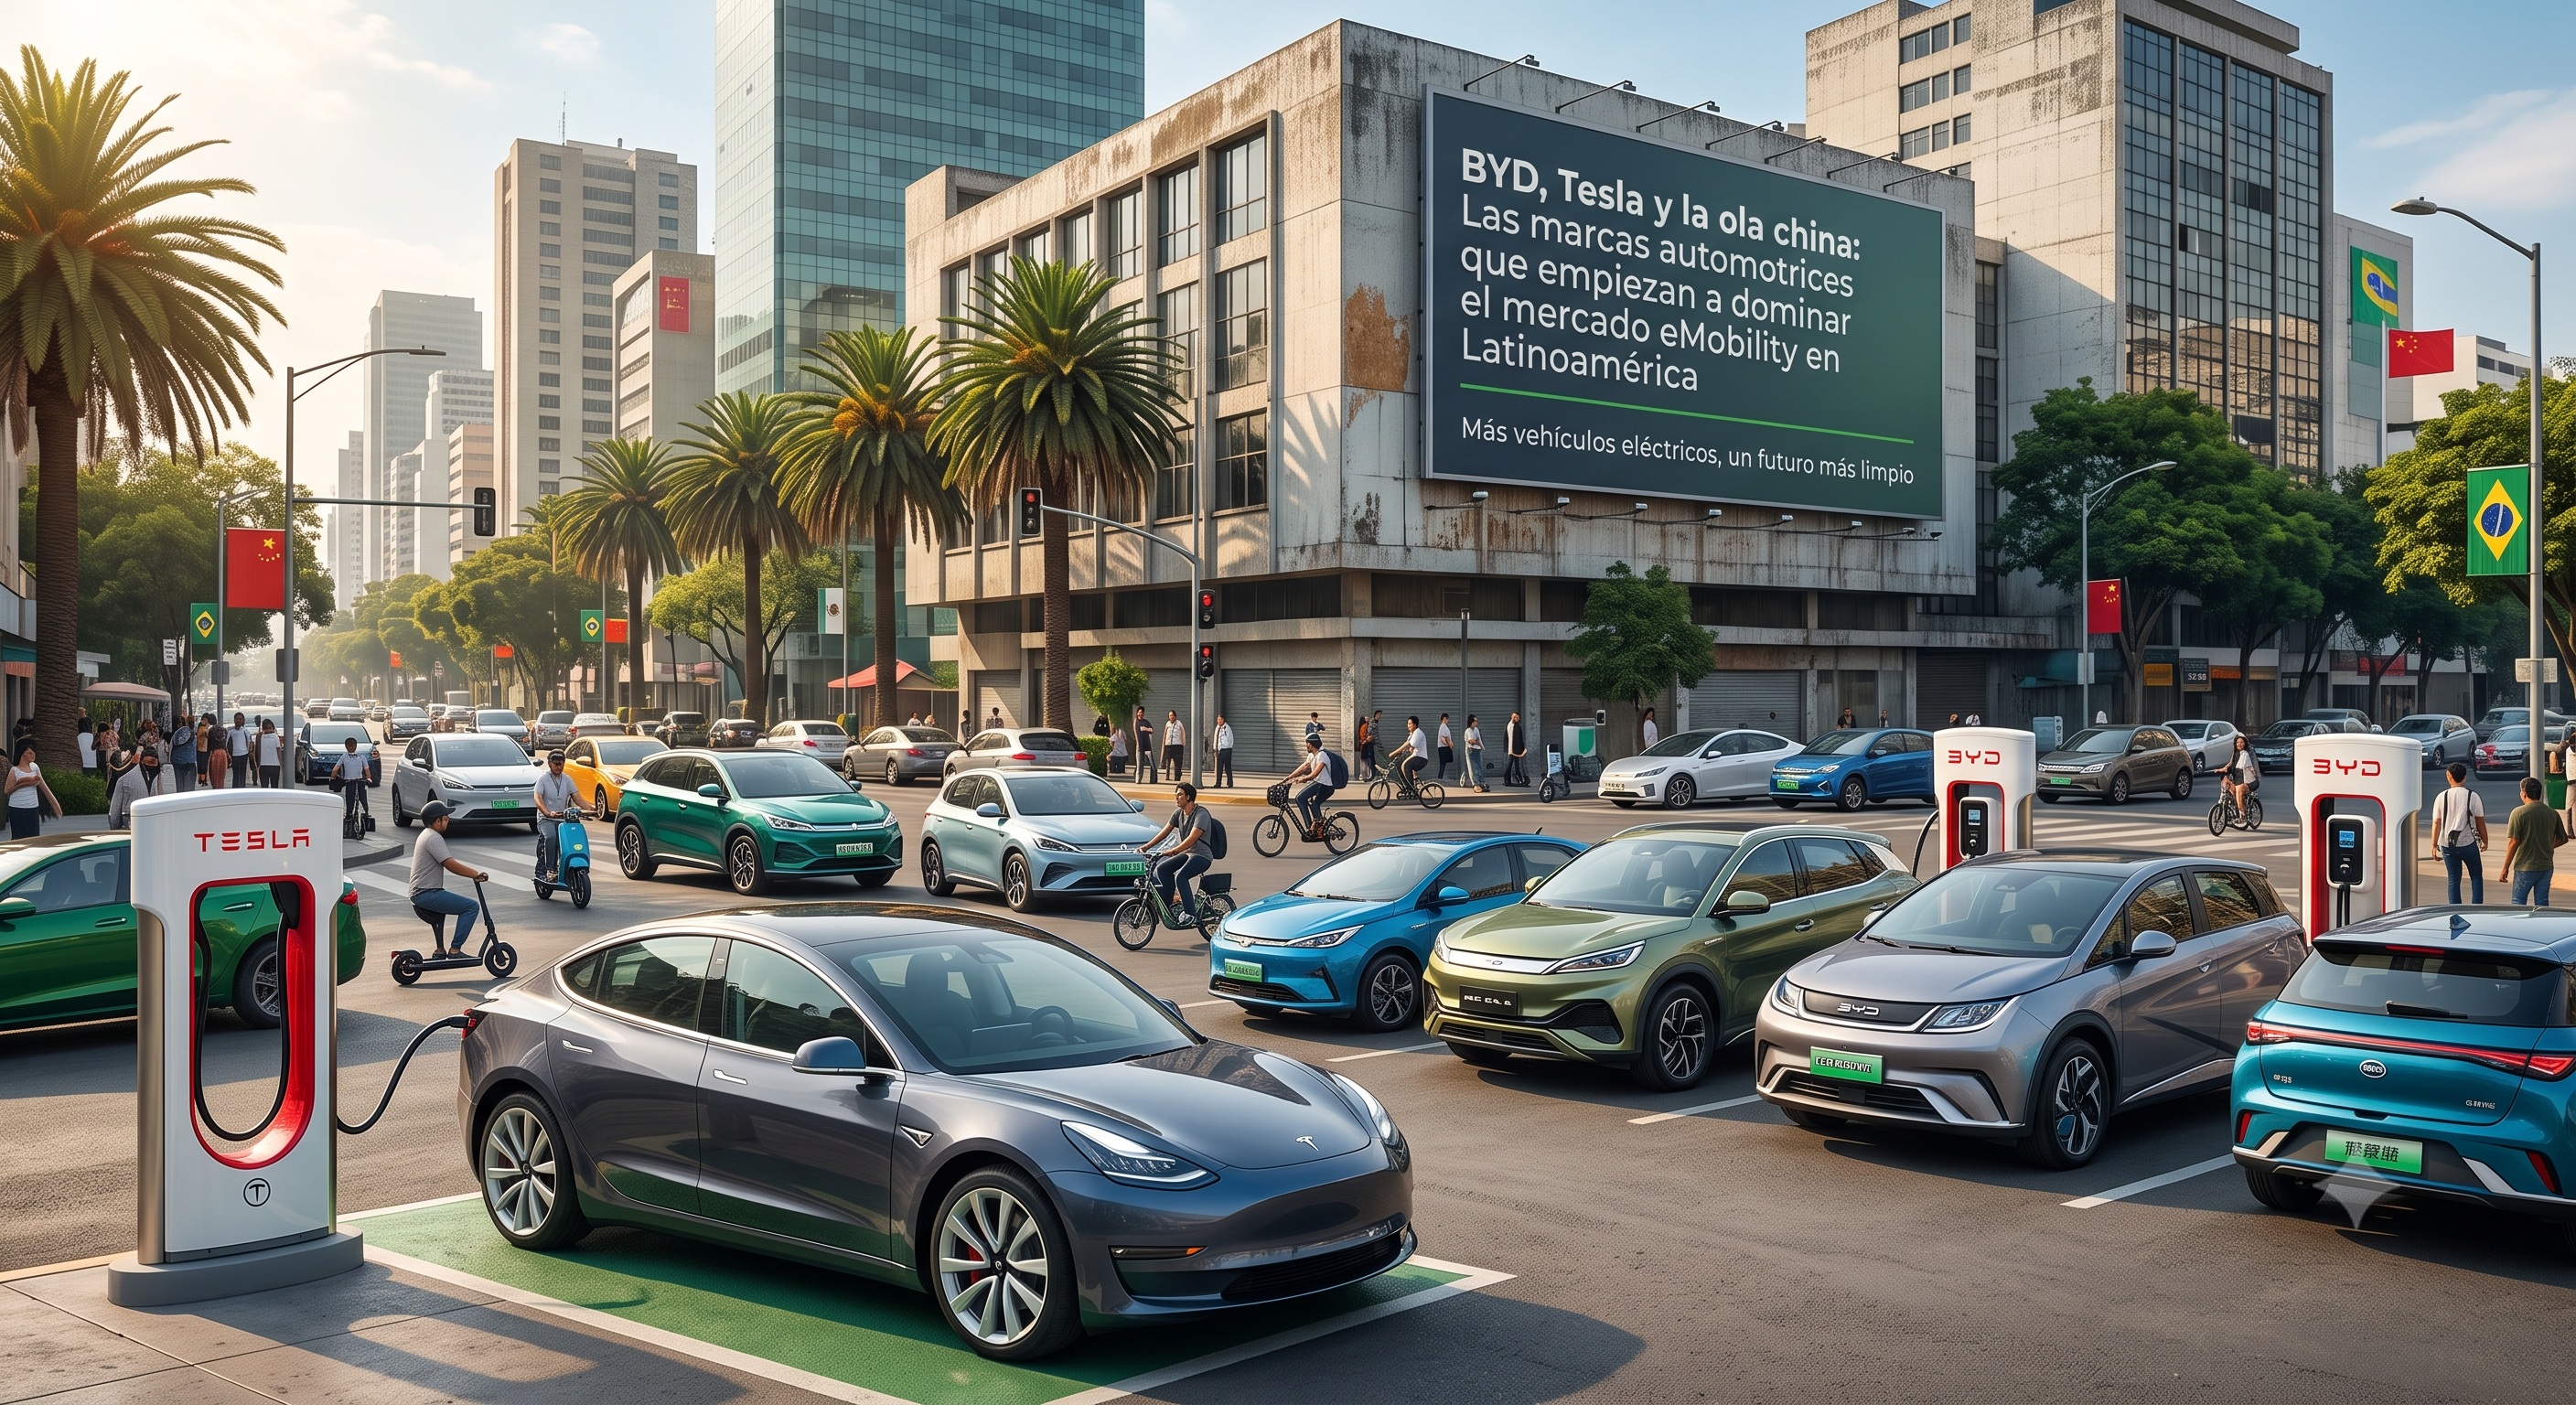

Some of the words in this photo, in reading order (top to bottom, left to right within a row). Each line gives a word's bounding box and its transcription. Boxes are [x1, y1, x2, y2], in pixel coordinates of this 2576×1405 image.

[1463, 147, 1548, 203] BYD,
[1558, 168, 1643, 216] Tesla
[1653, 196, 1673, 228] y
[1683, 193, 1708, 230] la
[1719, 205, 1764, 241] ola
[1774, 217, 1860, 261] china:
[1464, 193, 1519, 234] Las
[1531, 214, 1650, 259] marcas
[1660, 241, 1853, 297] automotrices
[1461, 246, 1528, 282] que
[1539, 260, 1695, 309] empiezan
[1706, 289, 1722, 314] a
[1732, 287, 1851, 335] dominar
[1461, 284, 1489, 318] el
[1504, 297, 1650, 342] mercado
[1660, 318, 1798, 372] eMobility
[1806, 347, 1839, 372] en
[1464, 327, 1697, 391] Latinoamérica
[1463, 416, 1508, 443] Más
[1513, 424, 1615, 454] vehículos
[1622, 434, 1722, 468] eléctricos,
[1729, 451, 1751, 467] un
[1757, 448, 1814, 474] futuro
[1819, 457, 1856, 478] más
[1862, 459, 1914, 487] limpio
[1948, 749, 2002, 766] BYD
[2313, 758, 2382, 778] BYD
[194, 828, 310, 853] TESLA
[1836, 1002, 1880, 1017] BYD
